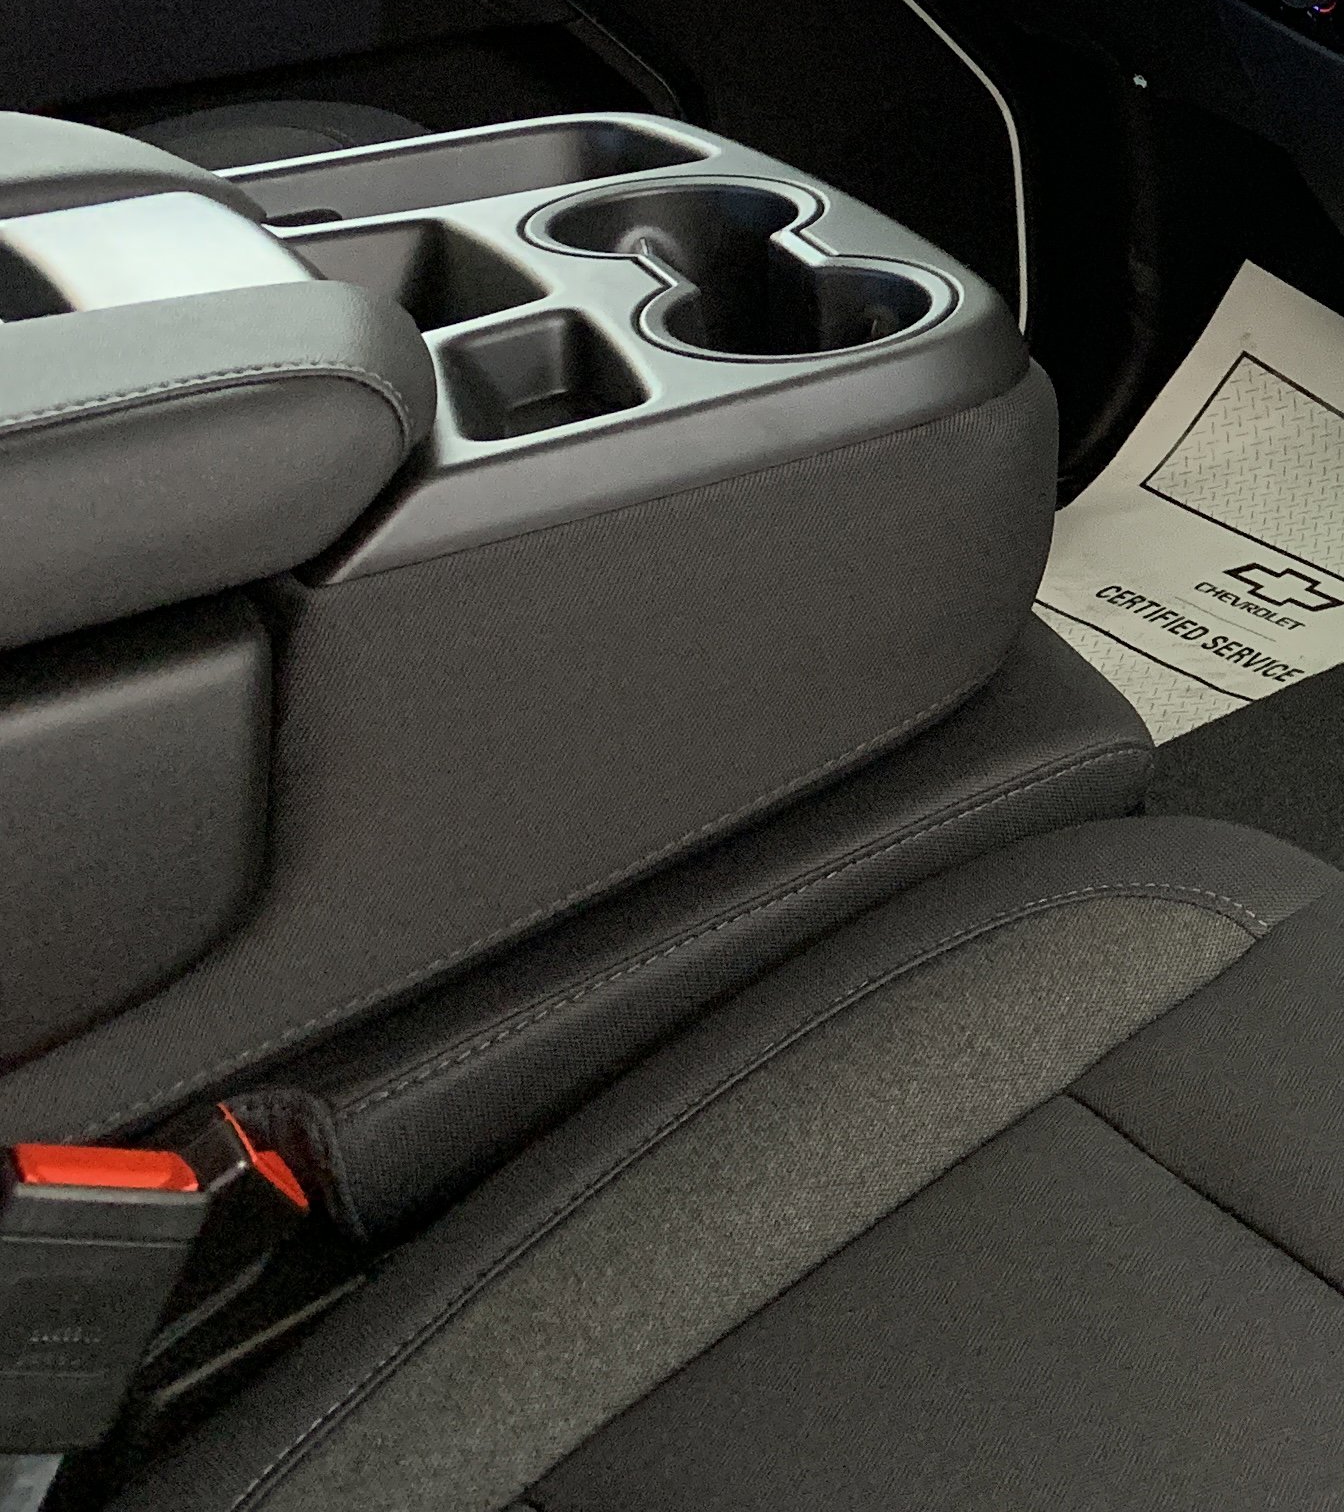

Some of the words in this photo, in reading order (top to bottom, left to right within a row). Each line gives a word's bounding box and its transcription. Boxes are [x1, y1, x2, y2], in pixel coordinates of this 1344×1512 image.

[1095, 585, 1210, 641] CERTIFIED
[1201, 636, 1305, 683] SERVICE
[1194, 581, 1306, 630] CHEVROLET
